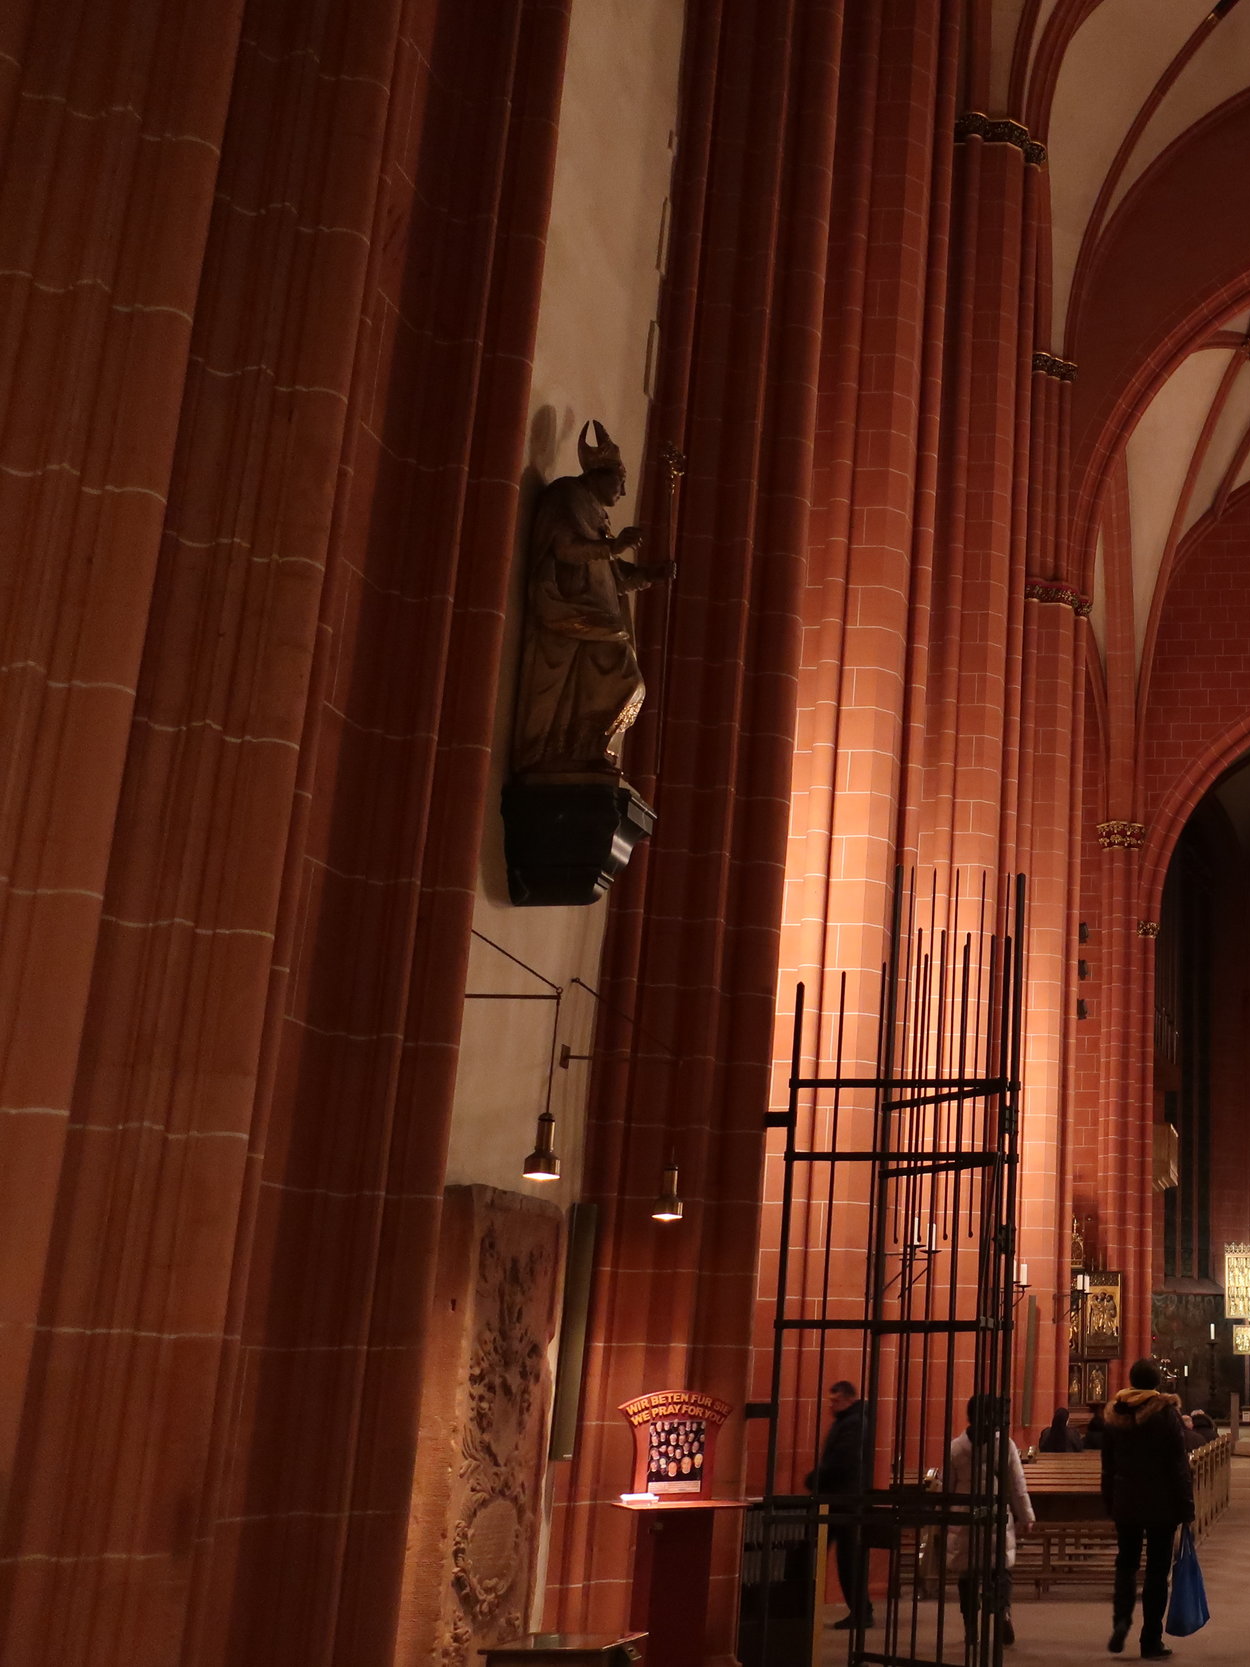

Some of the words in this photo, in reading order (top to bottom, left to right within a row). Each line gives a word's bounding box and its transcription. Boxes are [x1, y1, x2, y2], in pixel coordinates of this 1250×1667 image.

[626, 1399, 649, 1415] WIR
[651, 1393, 688, 1406] BETEN
[713, 1400, 730, 1416] SIE
[630, 1410, 651, 1426] WE
[651, 1404, 681, 1418] PRAY
[681, 1405, 704, 1417] FOR
[704, 1409, 726, 1425] YOU
